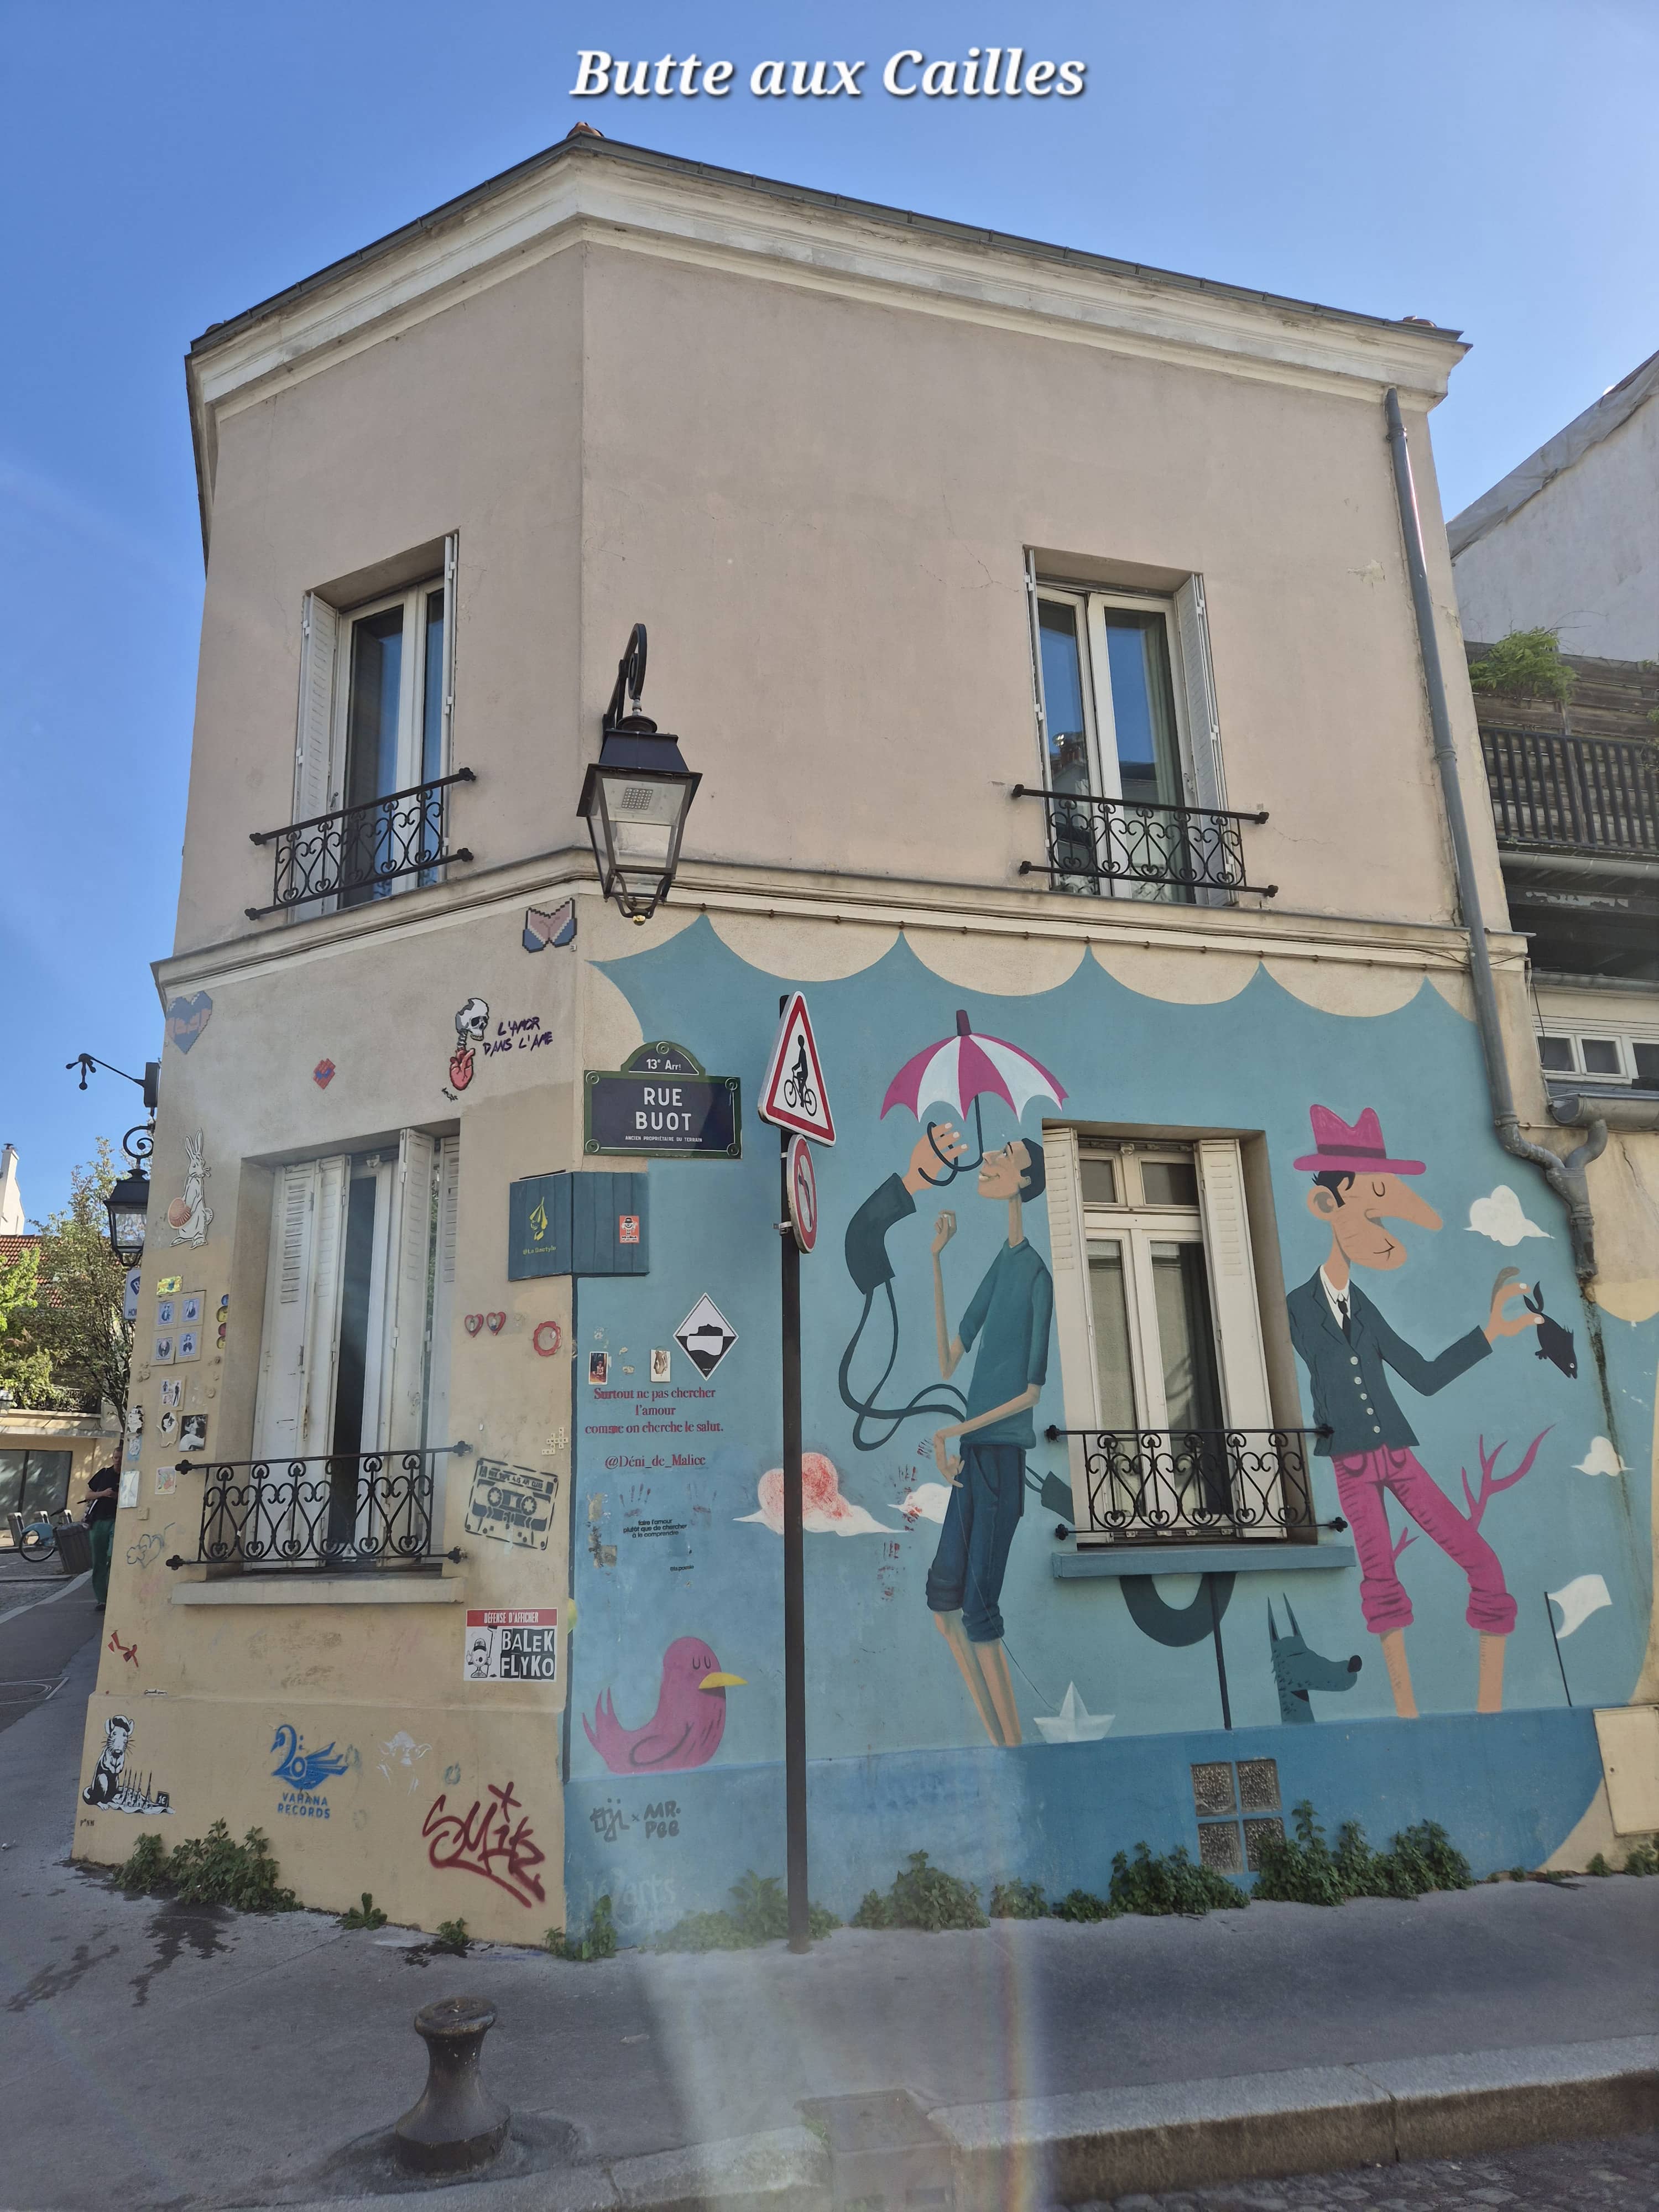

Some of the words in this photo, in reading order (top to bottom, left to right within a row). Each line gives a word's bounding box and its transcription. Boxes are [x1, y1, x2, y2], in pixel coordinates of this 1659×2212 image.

[483, 1038, 513, 1057] DANS
[644, 1087, 683, 1107] RUE
[635, 1111, 692, 1131] BUOT
[593, 1387, 635, 1399] Surtout
[651, 1391, 669, 1402] pas
[671, 1387, 716, 1399] chercher
[635, 1404, 676, 1416] l'amour
[626, 1425, 639, 1433] on
[642, 1421, 682, 1433] cherche
[685, 1421, 694, 1432] le
[696, 1420, 724, 1432] salut.
[484, 1611, 507, 1624] DÉFENSE
[508, 1611, 539, 1624] D'AFFICHER
[502, 1629, 554, 1652] BALEK
[501, 1654, 555, 1677] FLYKO
[283, 1792, 328, 1807] VAHANA
[278, 1802, 331, 1819] RECORDS
